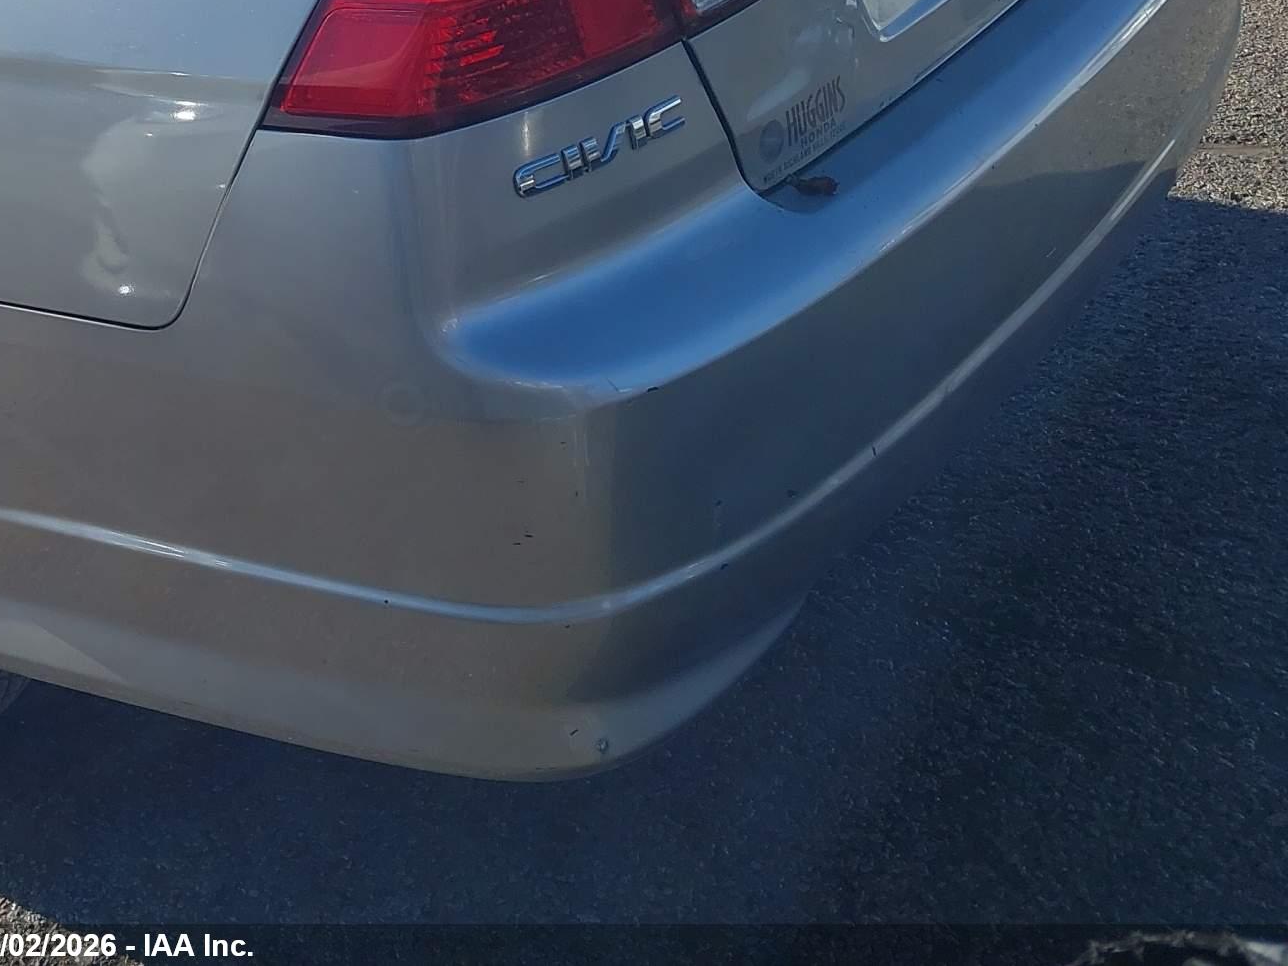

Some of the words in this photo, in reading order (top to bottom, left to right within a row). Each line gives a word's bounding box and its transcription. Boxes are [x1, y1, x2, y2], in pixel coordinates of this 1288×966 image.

[513, 94, 686, 199] CIVIC
[785, 74, 846, 147] HUGGINS
[800, 116, 837, 151] HONDA
